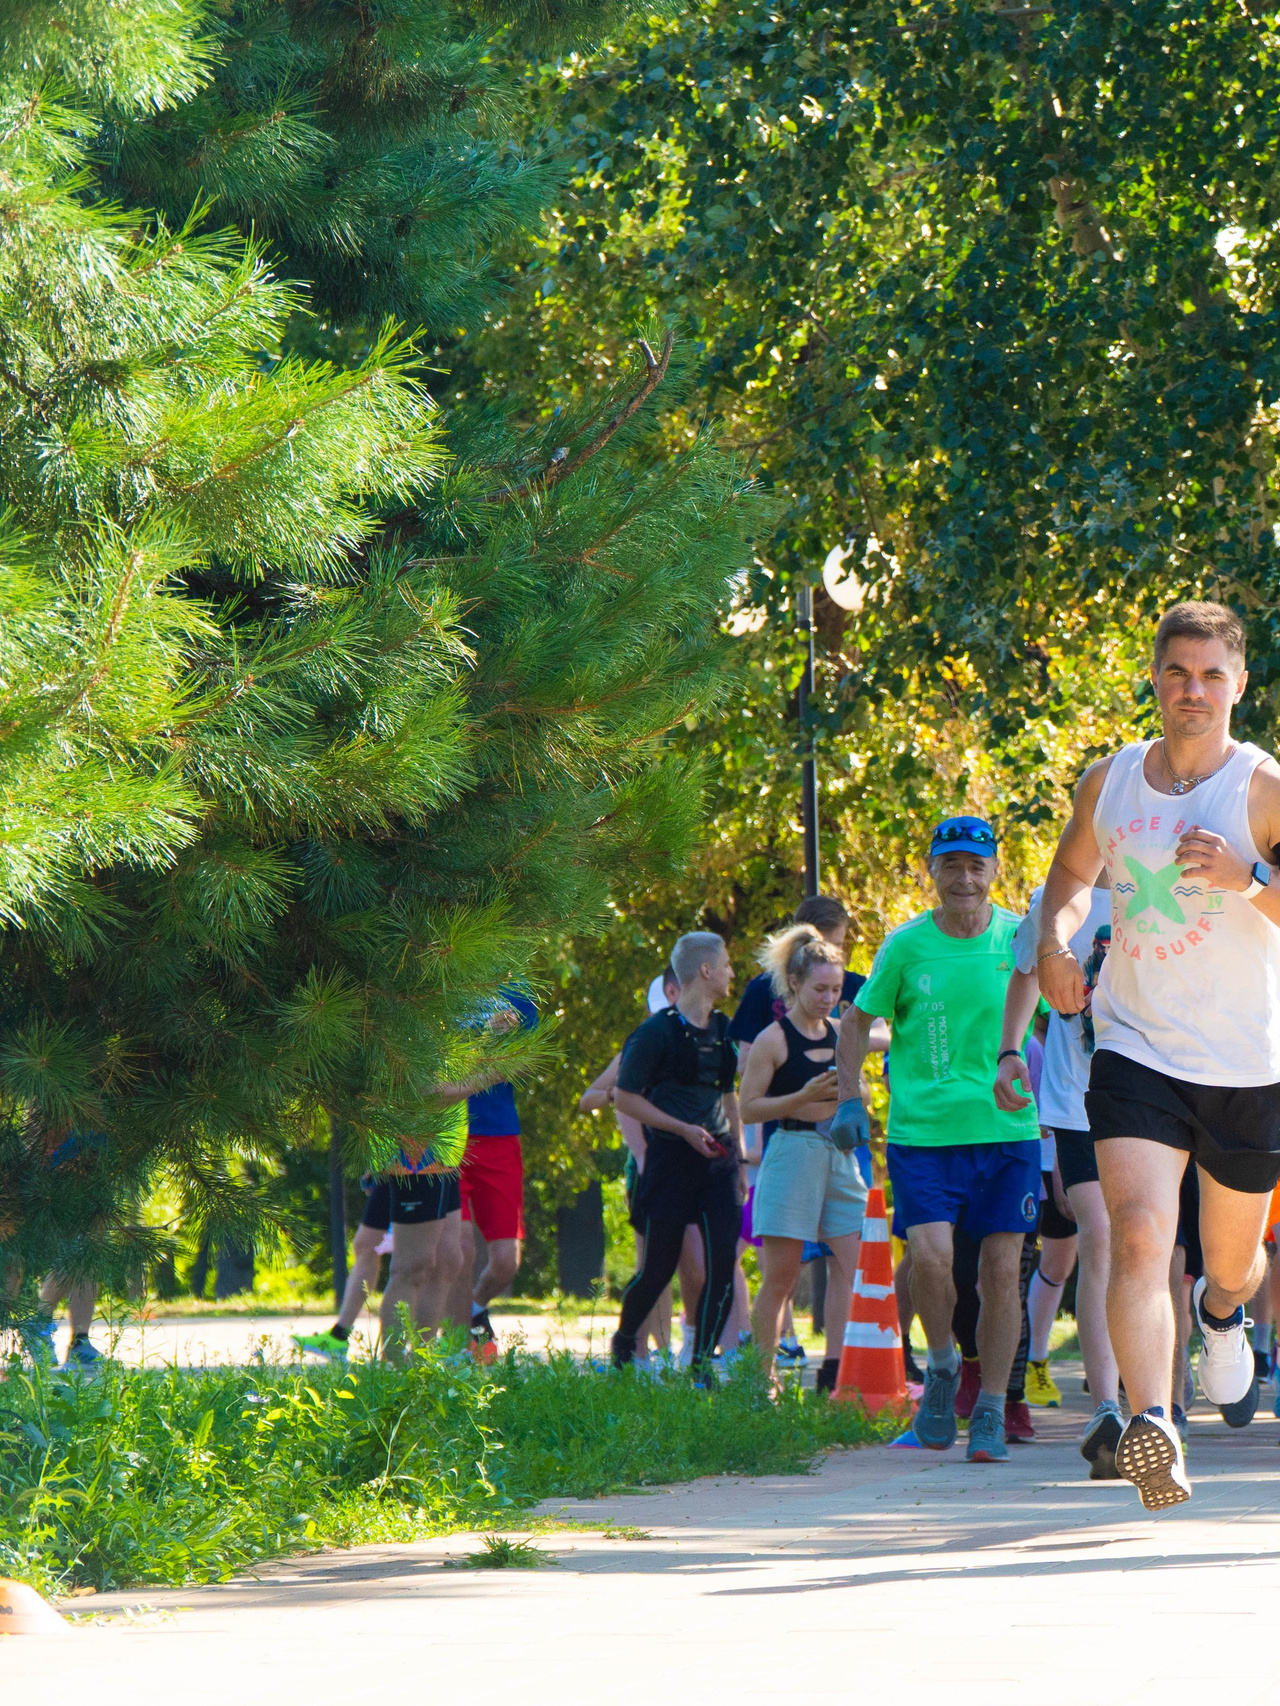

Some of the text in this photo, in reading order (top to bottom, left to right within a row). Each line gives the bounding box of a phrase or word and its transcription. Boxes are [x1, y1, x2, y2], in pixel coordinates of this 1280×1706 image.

[1207, 895, 1223, 909] 19
[1154, 917, 1211, 960] SURF
[931, 1001, 945, 1011] 05
